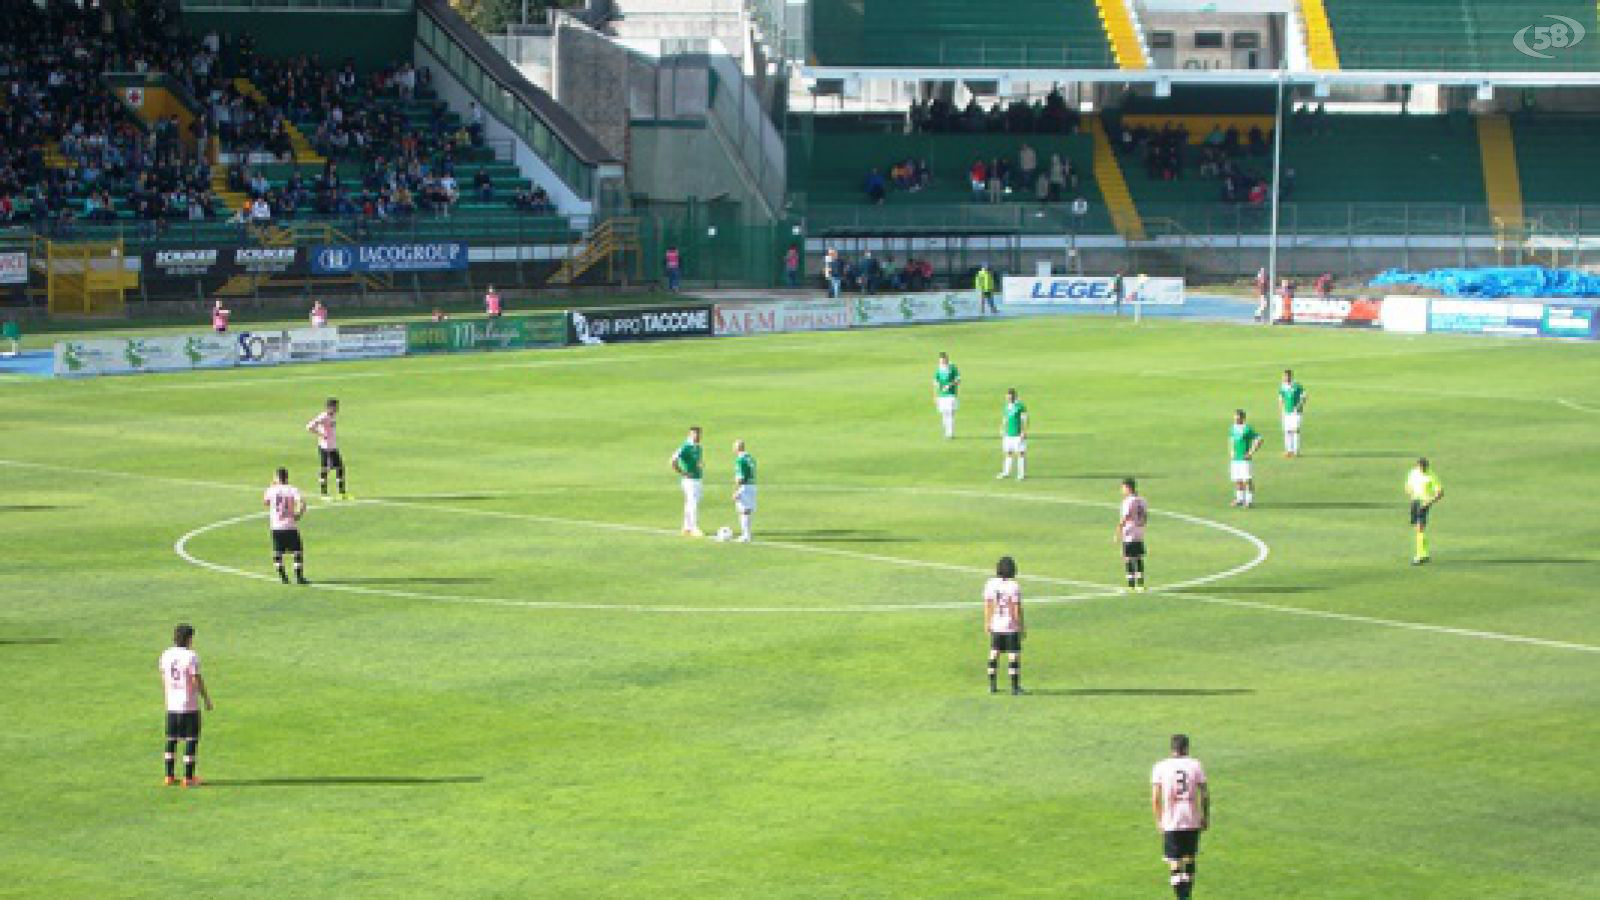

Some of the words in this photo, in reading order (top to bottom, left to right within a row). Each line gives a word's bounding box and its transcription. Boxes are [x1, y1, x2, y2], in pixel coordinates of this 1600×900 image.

[641, 310, 709, 332] TACCONE
[170, 659, 181, 681] 6
[1176, 769, 1189, 796] 3
